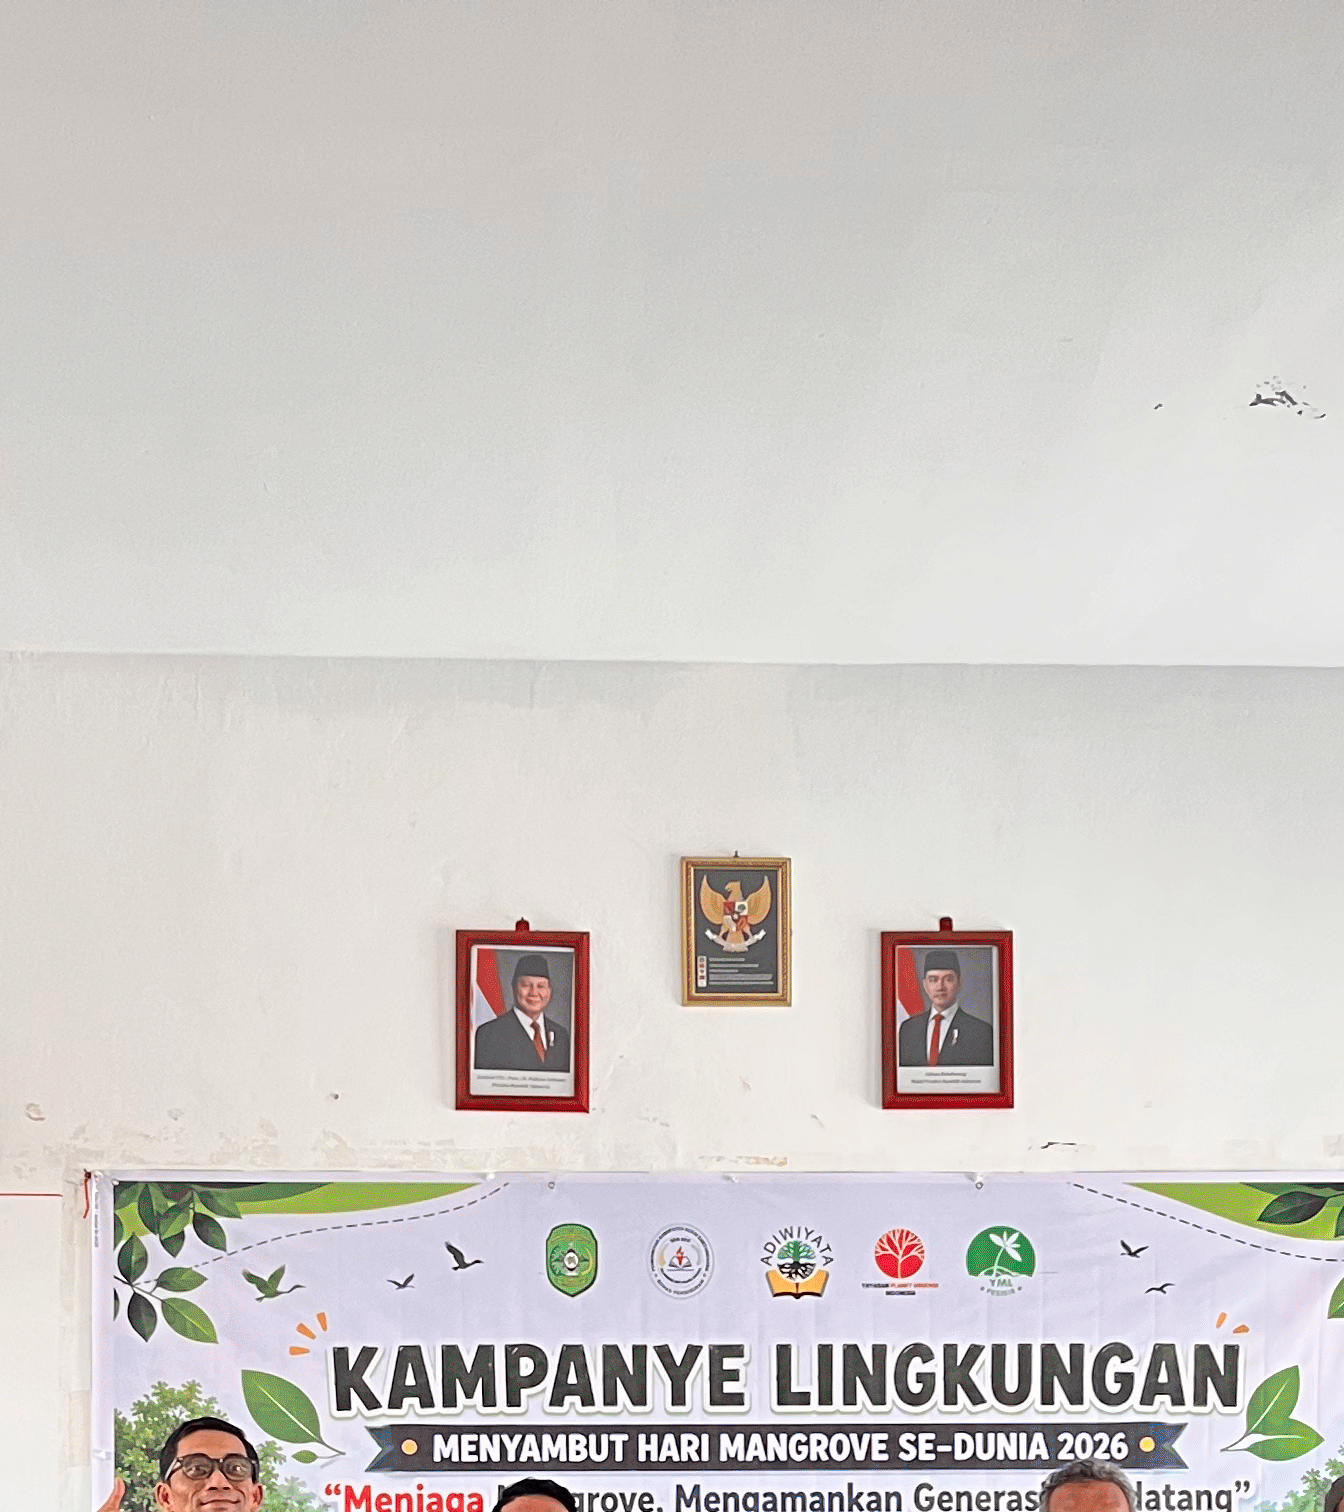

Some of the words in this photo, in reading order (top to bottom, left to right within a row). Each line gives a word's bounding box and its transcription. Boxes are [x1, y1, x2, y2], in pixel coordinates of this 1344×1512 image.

[760, 1226, 834, 1267] ADIWIYATA
[333, 1342, 745, 1412] KAMPANYE
[775, 1341, 1240, 1408] LINGKUNGAN
[433, 1434, 627, 1464] MENYAMBUT
[637, 1434, 711, 1463] HARI
[719, 1433, 889, 1462] MANGROVE
[898, 1433, 1049, 1462] SE-DUNIA
[1056, 1432, 1128, 1461] 2026
[914, 1483, 1040, 1512] Generas
